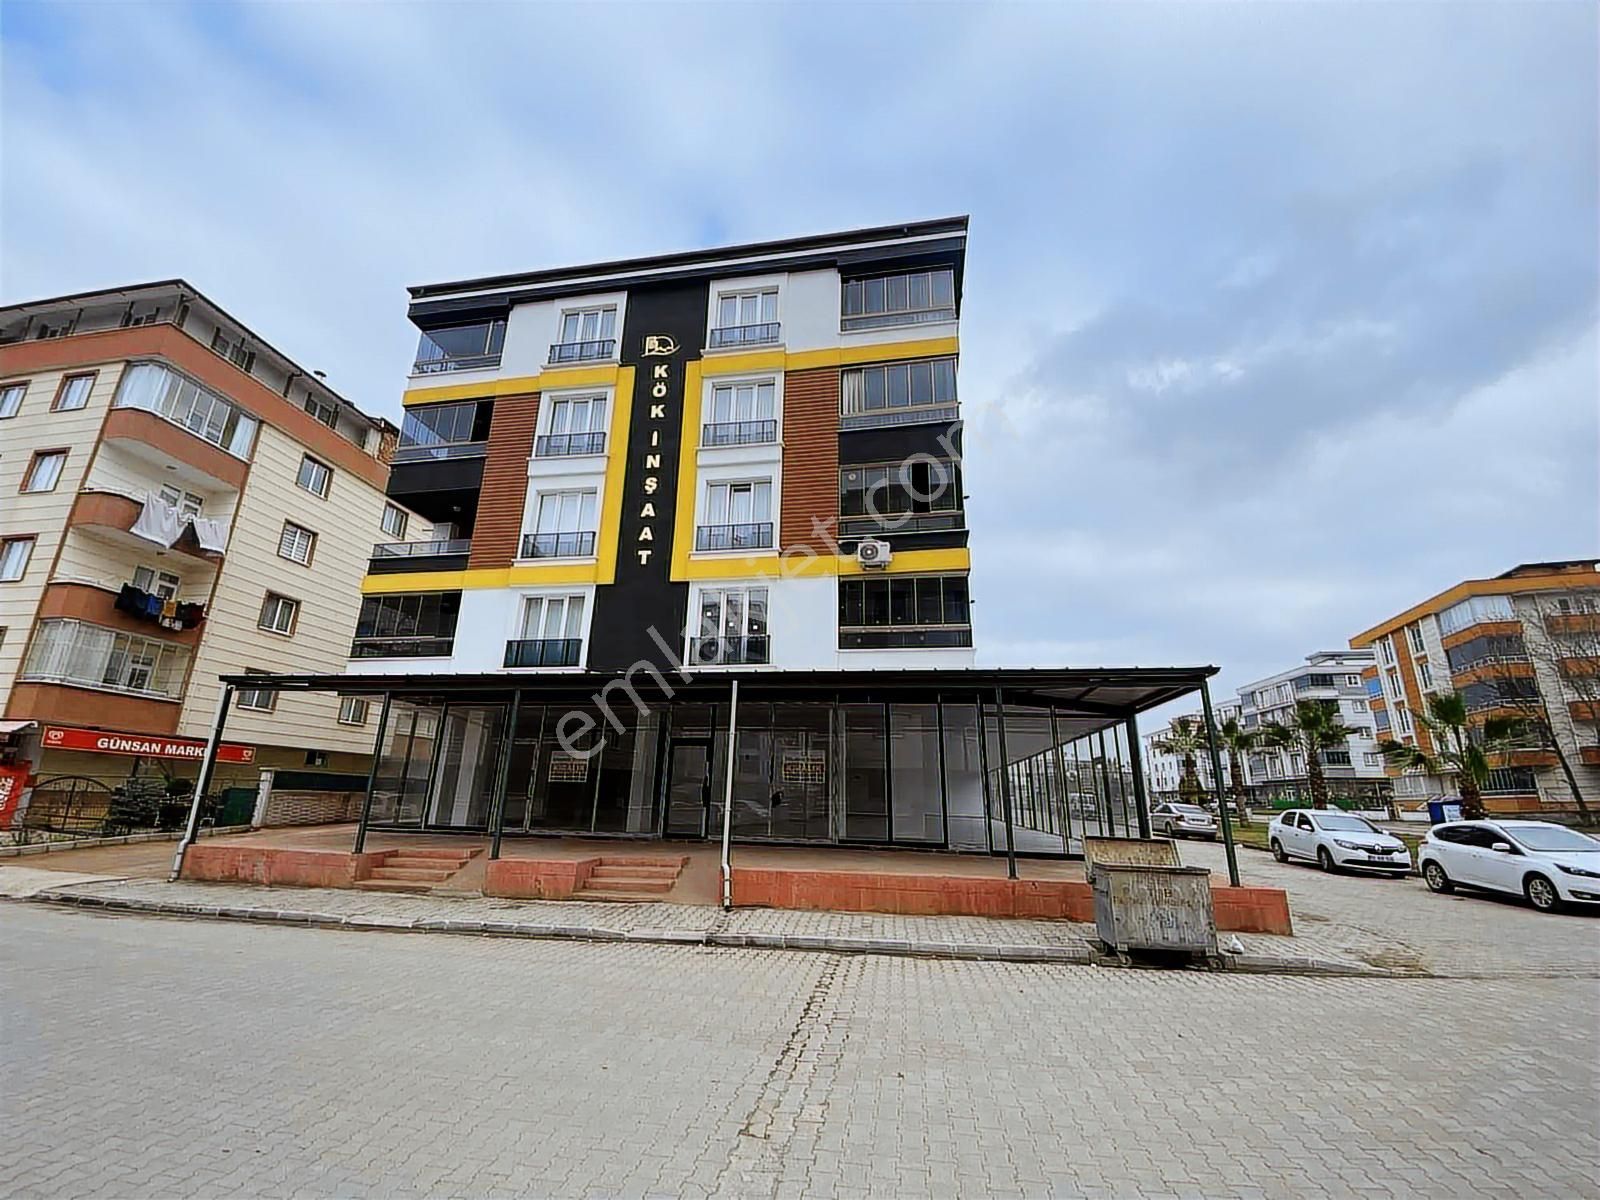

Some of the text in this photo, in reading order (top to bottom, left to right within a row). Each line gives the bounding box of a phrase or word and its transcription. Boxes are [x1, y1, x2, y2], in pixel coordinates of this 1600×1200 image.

[650, 364, 669, 419] KÖK
[97, 737, 219, 758] GÜNSAN MARK
